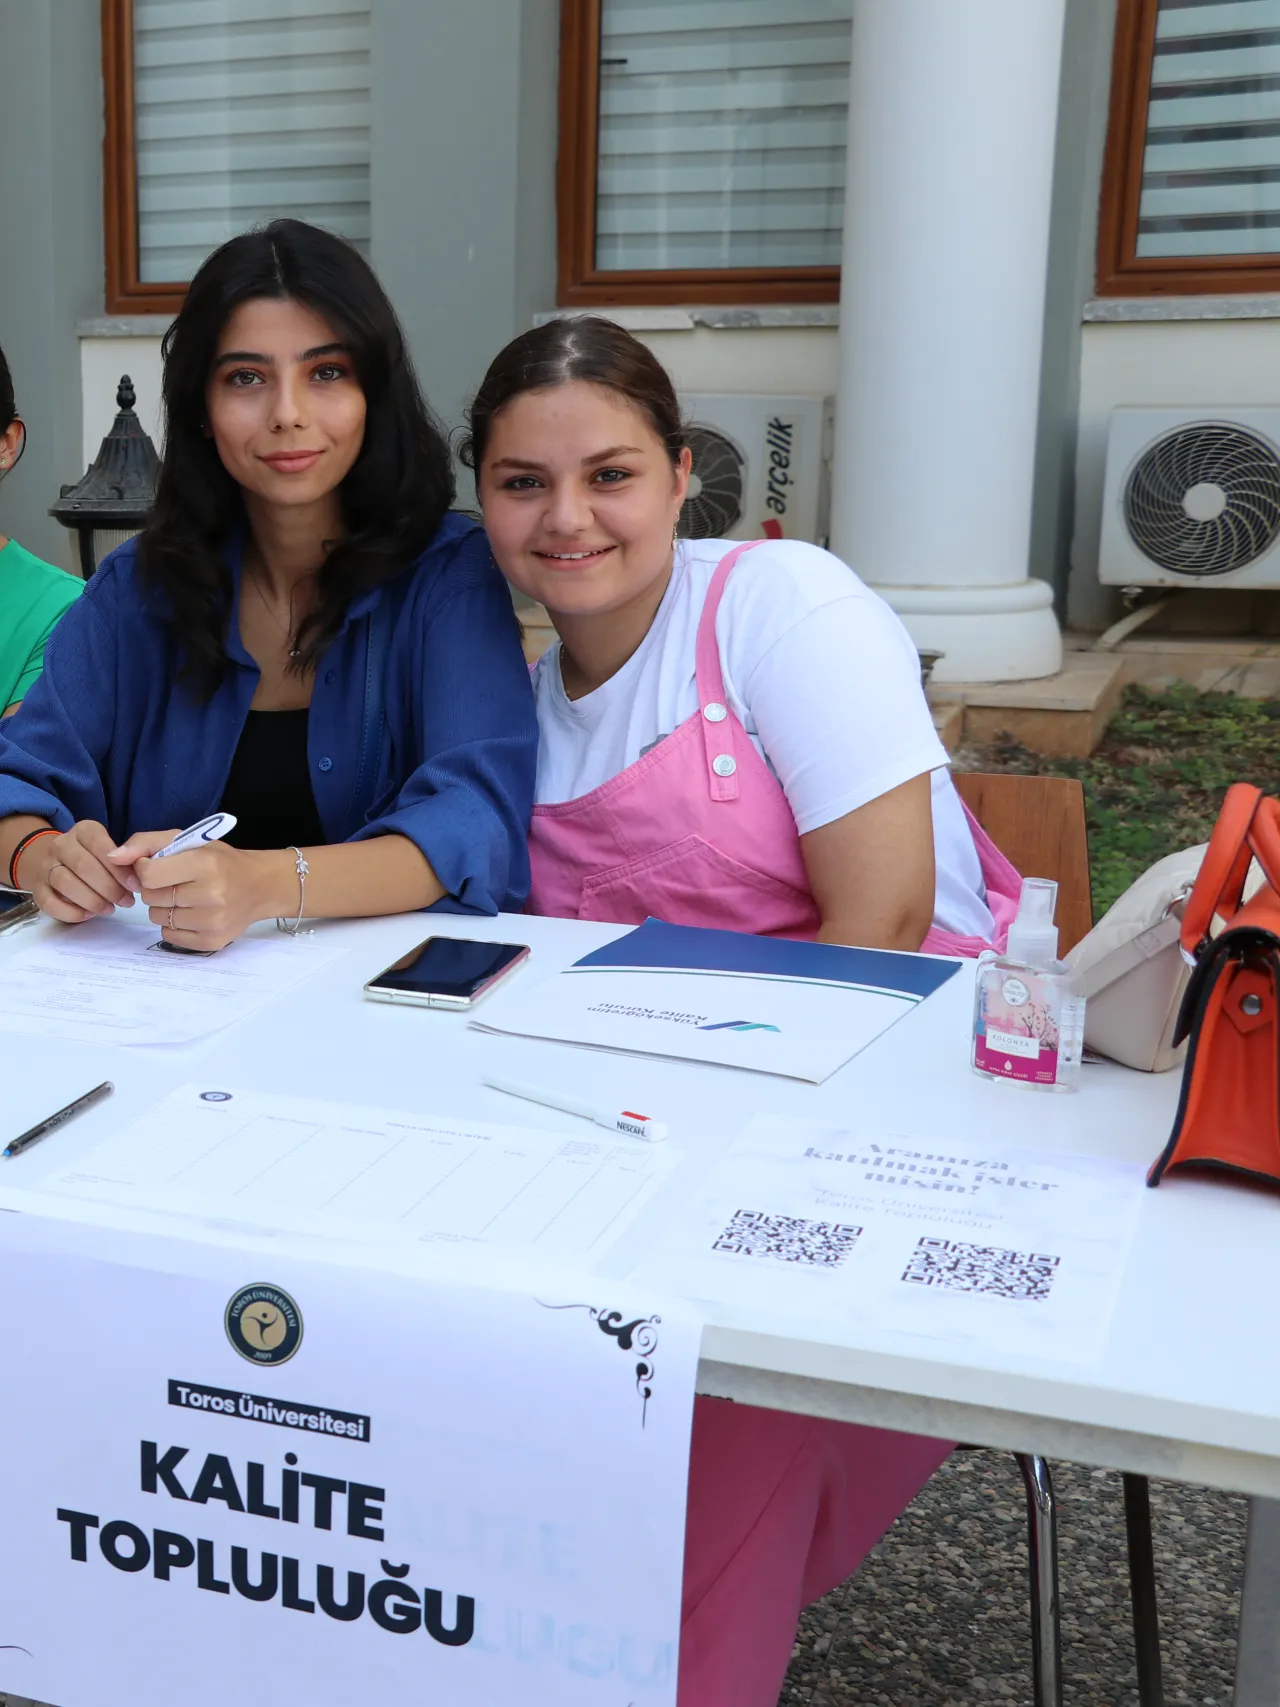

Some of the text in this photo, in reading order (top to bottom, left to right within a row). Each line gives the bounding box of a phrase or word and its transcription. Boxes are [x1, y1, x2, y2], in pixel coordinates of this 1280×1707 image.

[765, 416, 794, 515] arçelik
[598, 1003, 709, 1022] Kalite Kurulu
[992, 1033, 1029, 1047] KOLONYA
[176, 1386, 365, 1439] Toros Üniversitesi
[139, 1439, 386, 1543] KALİTE
[56, 1507, 476, 1648] TOPLULUĞU
